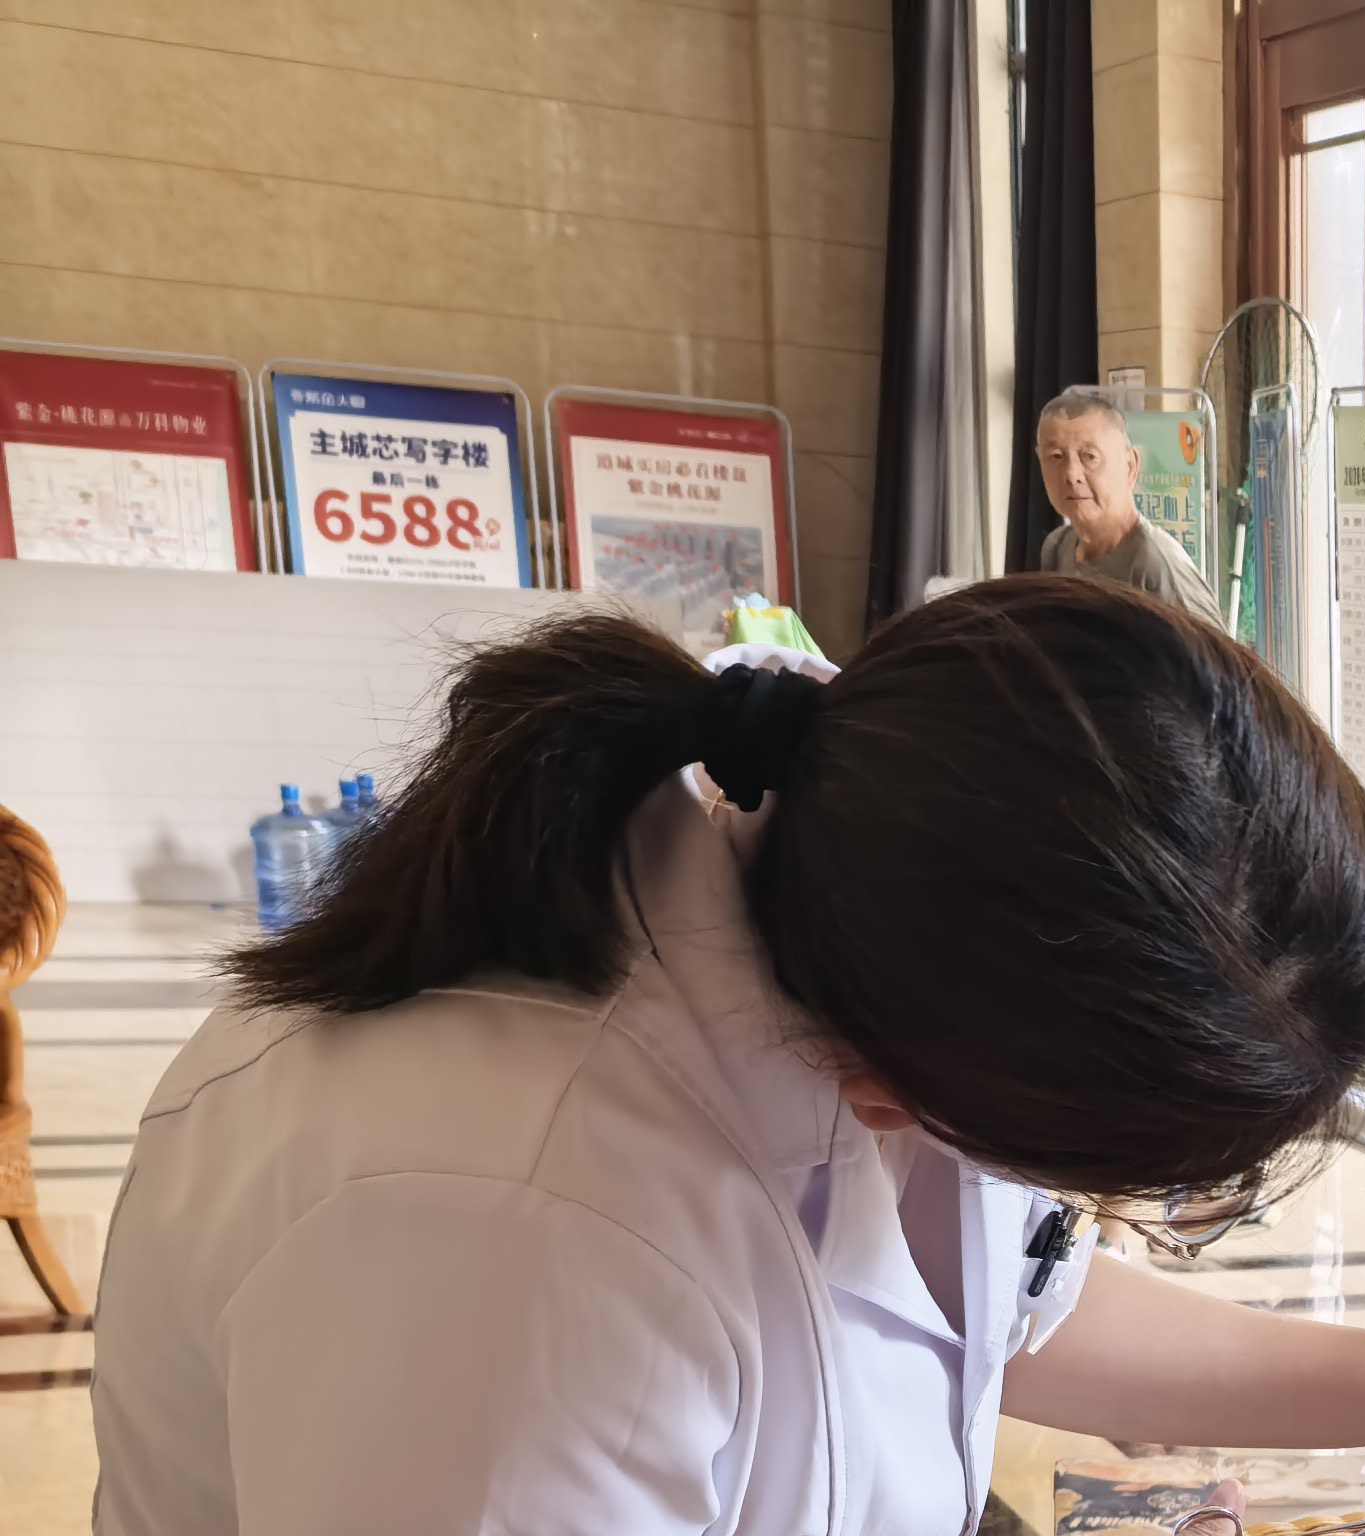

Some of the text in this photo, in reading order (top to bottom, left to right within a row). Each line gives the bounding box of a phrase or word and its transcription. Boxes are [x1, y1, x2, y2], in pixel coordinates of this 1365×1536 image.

[310, 428, 489, 469] 主城芯写字楼
[313, 489, 484, 551] 6588
